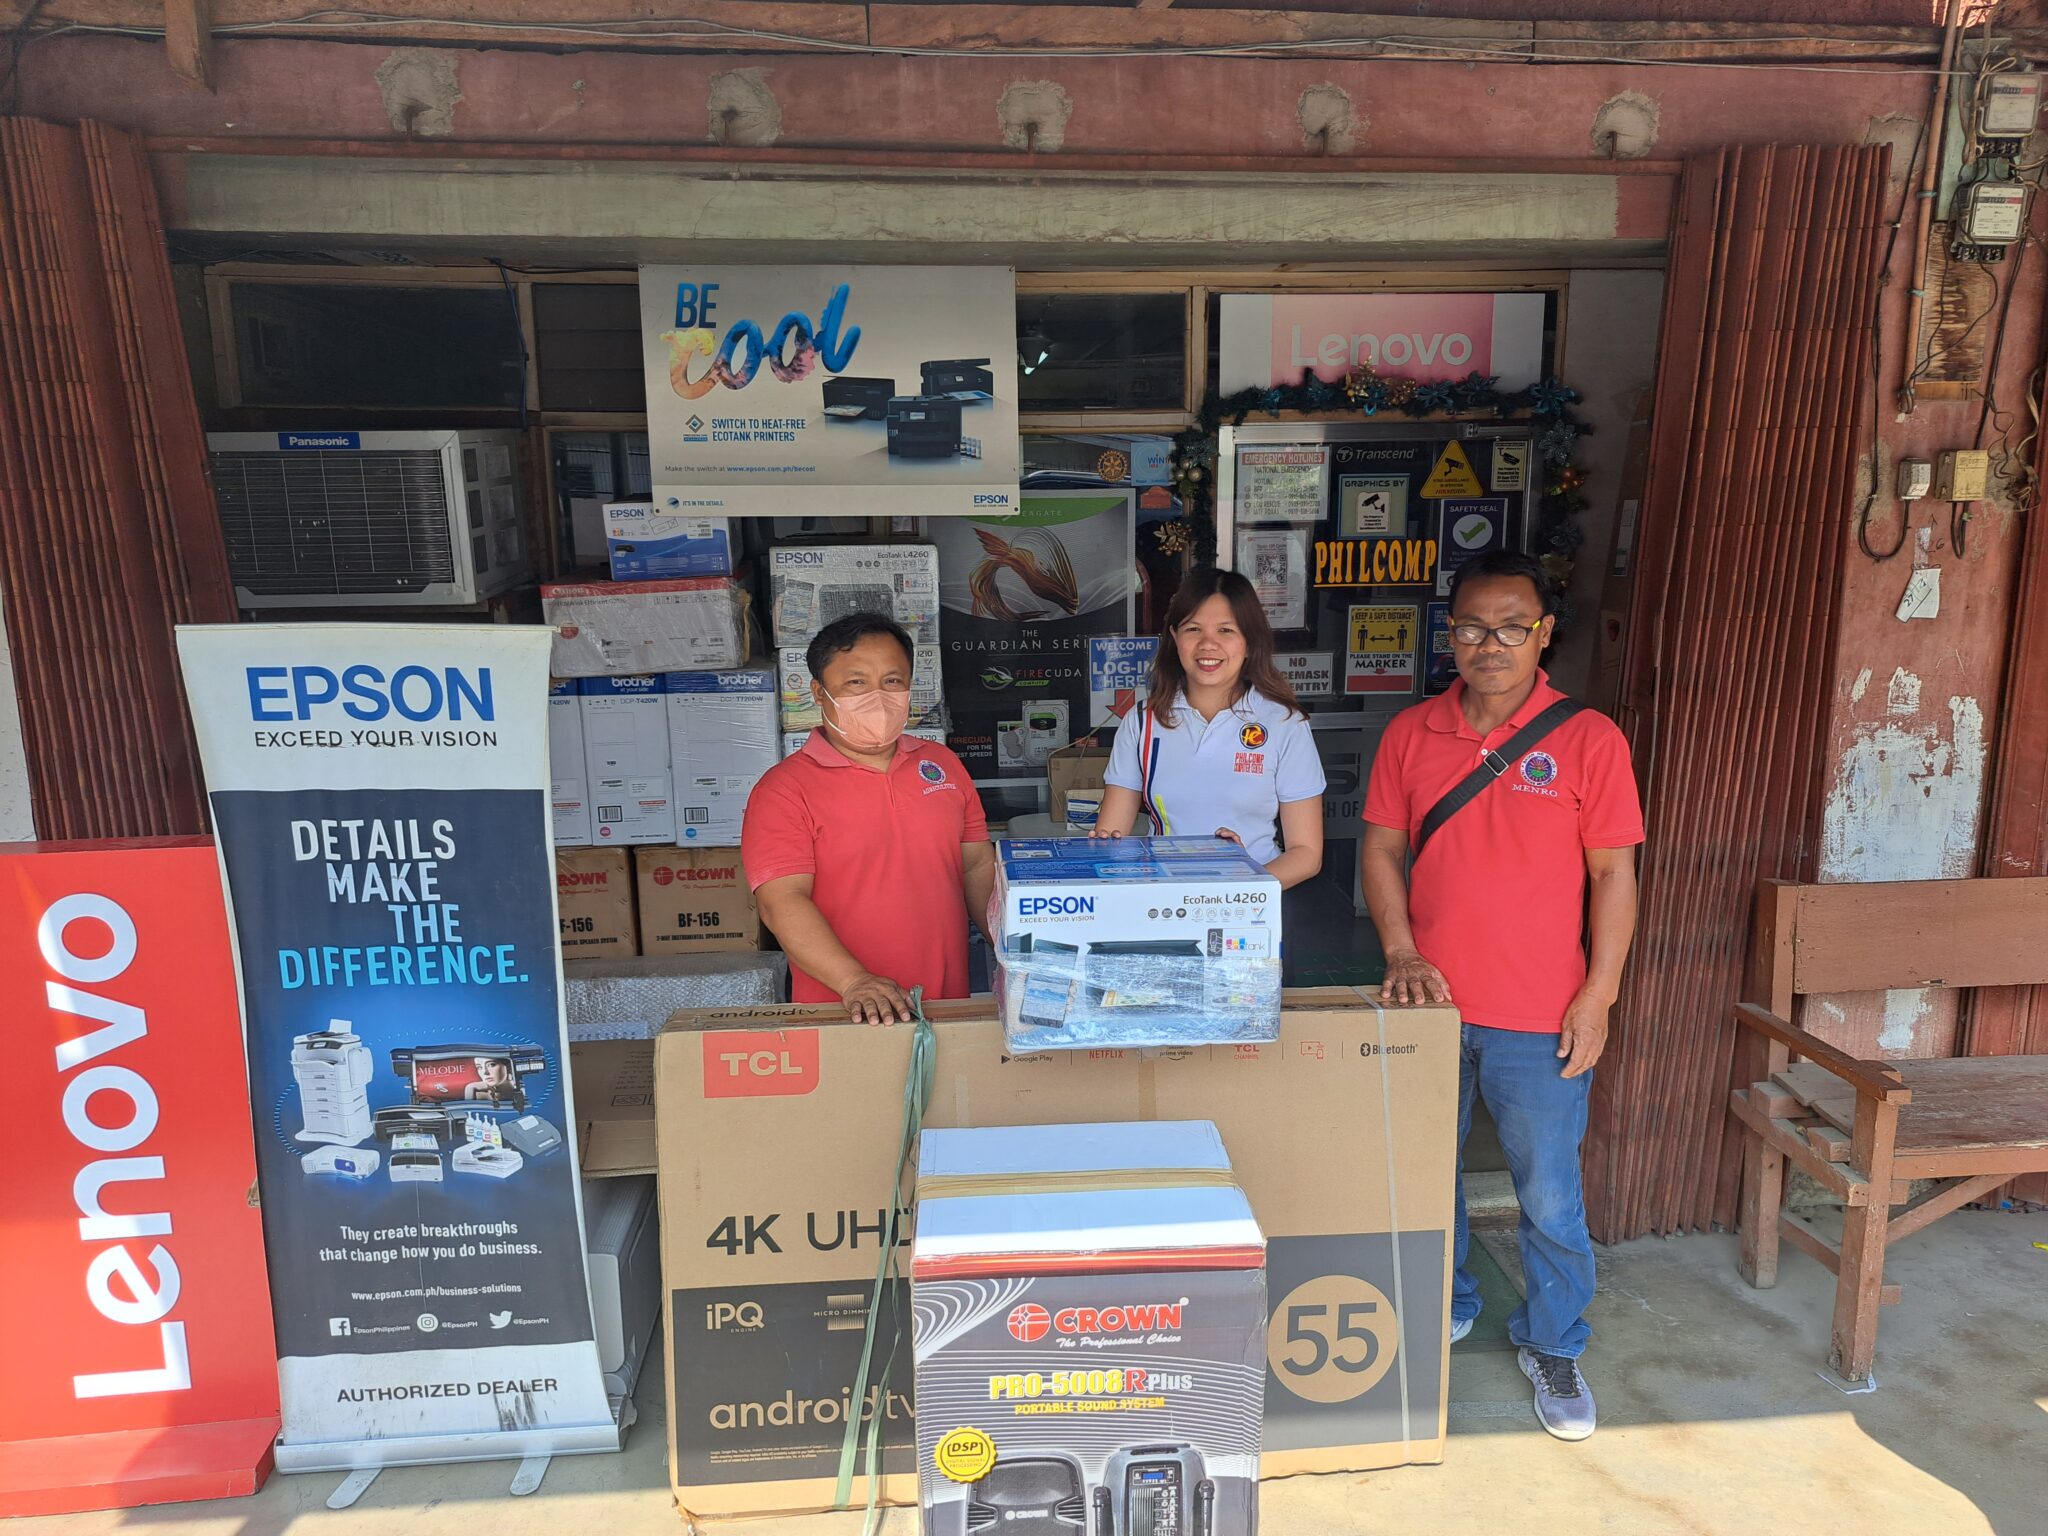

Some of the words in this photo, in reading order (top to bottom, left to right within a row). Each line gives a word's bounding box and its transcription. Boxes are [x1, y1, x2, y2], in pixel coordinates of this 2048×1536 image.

[675, 283, 719, 328] BE
[660, 282, 861, 399] cool
[1291, 325, 1472, 367] Lenovo
[712, 418, 748, 429] SWITCH
[749, 418, 760, 429] TO
[762, 418, 806, 429] HEAT-FREE
[289, 436, 349, 446] Panasonic
[712, 431, 751, 442] ECOTANK
[754, 431, 795, 442] PRINTERS
[1245, 454, 1286, 464] EMERGENCY
[1289, 453, 1323, 463] HOTLINES
[1356, 448, 1415, 460] Transcend
[726, 466, 816, 474] www.epson.com.ph/becool
[974, 495, 1008, 503] EPSON
[610, 508, 644, 518] EPSON
[1449, 505, 1477, 513] SAFETY
[776, 552, 823, 564] EPSON
[1315, 540, 1436, 583] PHILCOMP
[1355, 612, 1368, 620] KEEP
[1388, 611, 1412, 619] DISTANCE
[952, 639, 1042, 651] GUARDIAN
[1053, 639, 1088, 649] SERI
[1096, 641, 1152, 651] WELCOME
[787, 653, 807, 662] EPS
[1289, 657, 1307, 667] NO
[1355, 659, 1407, 668] MARKER
[1015, 668, 1082, 678] FIRECUDA
[1281, 670, 1329, 679] CEMASK
[611, 676, 655, 687] brother
[717, 675, 763, 686] brother
[1103, 675, 1146, 688] HERE
[246, 665, 495, 722] EPSON
[254, 730, 342, 747] EXCEED
[351, 730, 413, 746] YOUR
[421, 731, 497, 747] VISION
[1512, 784, 1558, 797] MENRO
[291, 819, 456, 861] DETAILS
[558, 872, 607, 886] ROWN
[676, 867, 735, 881] CROWN
[326, 861, 441, 903] MAKE
[1019, 896, 1095, 915] EPSON
[1183, 895, 1223, 905] EcoTank
[1225, 892, 1267, 904] L4260
[388, 904, 463, 944] THE
[560, 917, 593, 932] F-156
[678, 912, 720, 927] BF-156
[278, 944, 529, 989] DIFFERENCE.
[1014, 1055, 1036, 1063] Google
[1038, 1054, 1053, 1063] Play
[1089, 1050, 1123, 1059] NETFLIX
[720, 1051, 802, 1076] TCL
[37, 893, 191, 1399] Lenovo
[340, 1226, 369, 1243] They
[374, 1225, 417, 1240] create
[421, 1221, 518, 1238] breakthroughs
[706, 1214, 783, 1255] 4K
[320, 1248, 348, 1261] that
[351, 1247, 398, 1263] change
[402, 1246, 429, 1258] how
[433, 1246, 456, 1260] you
[460, 1243, 476, 1257] do
[479, 1241, 542, 1255] business.
[351, 1283, 522, 1301] www.epson.com.ph/business-solutions
[706, 1301, 765, 1329] iPQ
[1054, 1303, 1182, 1334] CROWN
[354, 1325, 410, 1334] EpsonPhilippines
[513, 1317, 549, 1325] @EpsonPH
[1056, 1337, 1076, 1348] The
[1080, 1336, 1143, 1348] Professional
[1147, 1333, 1181, 1344] Choice
[1283, 1302, 1380, 1375] 55
[337, 1382, 471, 1404] AUTHORIZED
[477, 1378, 559, 1397] DEALER
[1015, 1402, 1073, 1415] PORTABLE
[1077, 1400, 1117, 1412] SOUND
[1120, 1397, 1166, 1409] SYSTEM
[951, 1442, 978, 1452] DSP
[1016, 1509, 1048, 1519] CROWN
